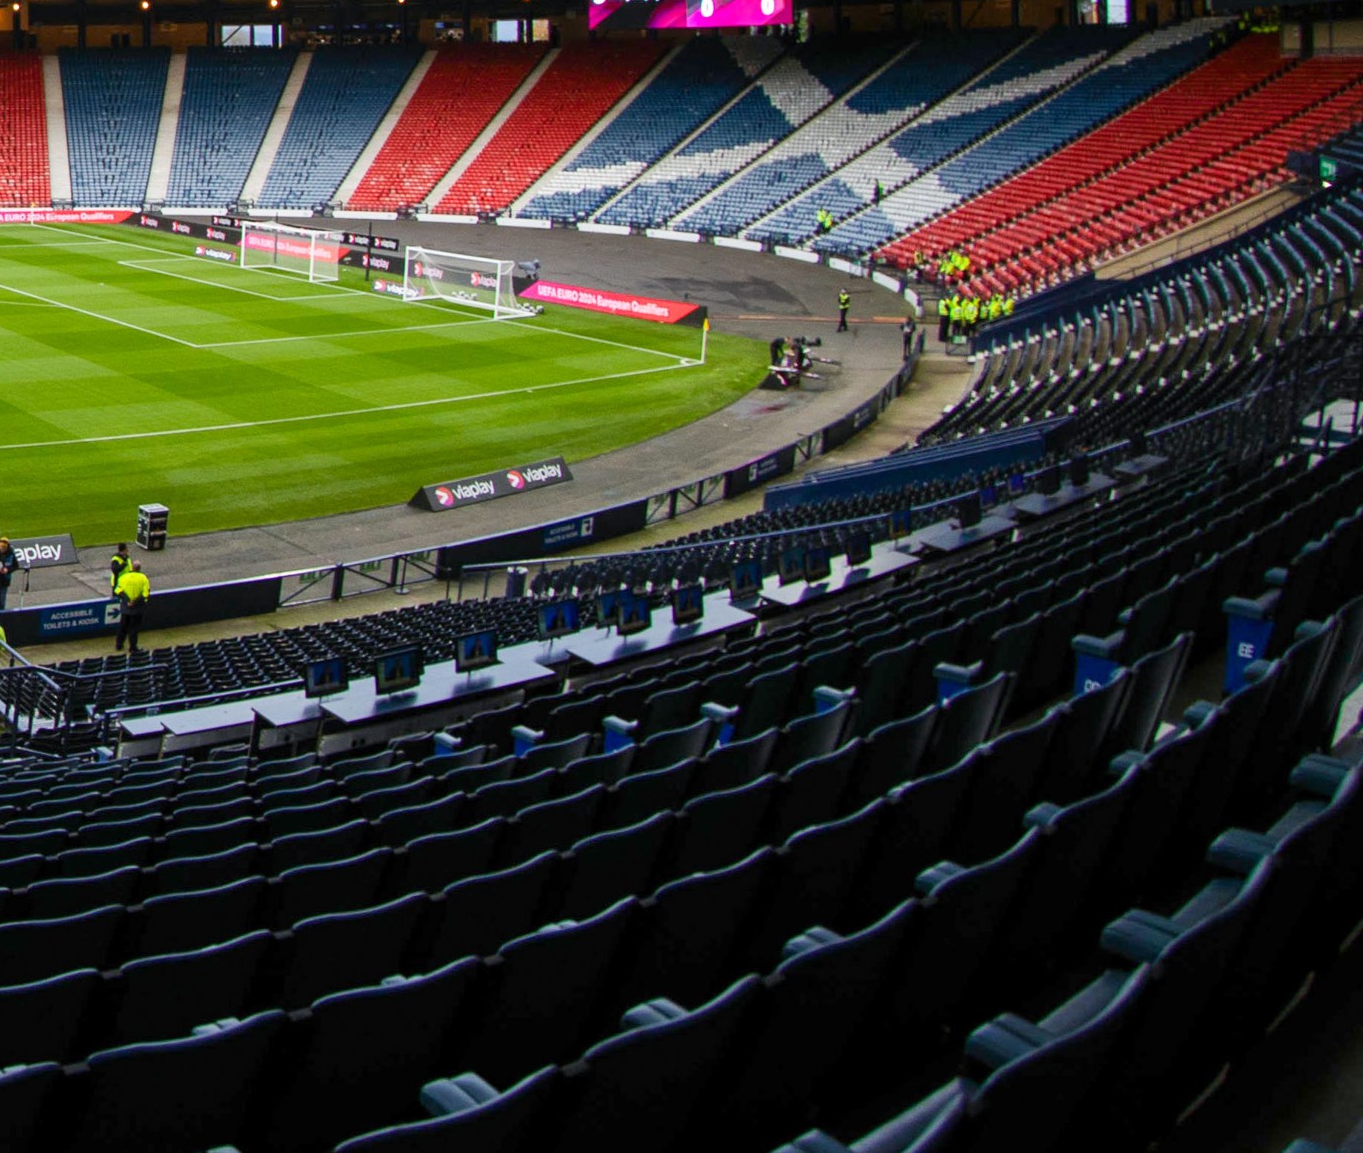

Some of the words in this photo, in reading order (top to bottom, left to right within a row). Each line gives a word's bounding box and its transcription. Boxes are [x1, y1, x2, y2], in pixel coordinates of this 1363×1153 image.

[4, 213, 25, 222] EURO
[46, 212, 79, 222] European
[80, 212, 114, 221] Qualifiers
[537, 285, 557, 297] UEFA
[557, 288, 578, 301] EURO
[578, 292, 596, 304] 2024
[596, 295, 632, 313] European
[631, 300, 669, 317] Qualifiers
[522, 463, 562, 482] viaplay
[452, 479, 495, 499] viaplay
[50, 609, 94, 620] ACCESSIBLE
[43, 621, 70, 630] TOILETS
[78, 617, 99, 626] KIOSK
